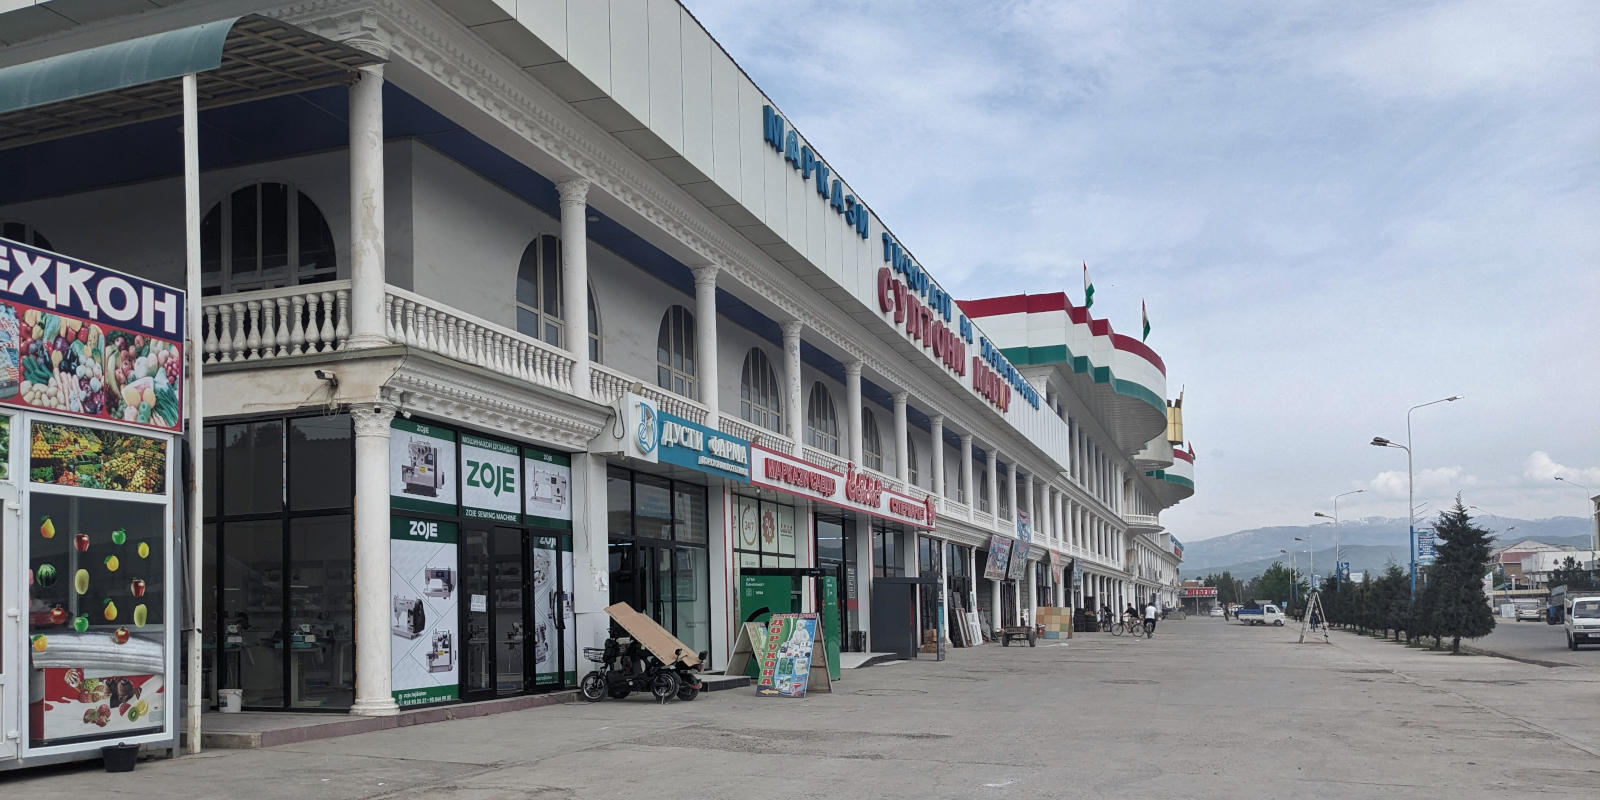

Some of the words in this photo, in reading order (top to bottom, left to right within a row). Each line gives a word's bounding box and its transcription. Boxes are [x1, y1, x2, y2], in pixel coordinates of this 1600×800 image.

[763, 105, 869, 239] МАРКАЗИ
[878, 267, 966, 377] СУЛТОНИ
[416, 424, 430, 435] ZOJE
[543, 453, 553, 462] ZOJE
[707, 436, 748, 464] ФАРМА
[466, 460, 515, 497] ZOJE
[765, 457, 809, 488] МАРКАЗИ
[465, 509, 478, 518] ZOJE
[478, 510, 496, 520] SEWING
[496, 512, 517, 522] MACHINE
[409, 521, 438, 540] ZOJE
[761, 619, 784, 686] ДОРУХОНА
